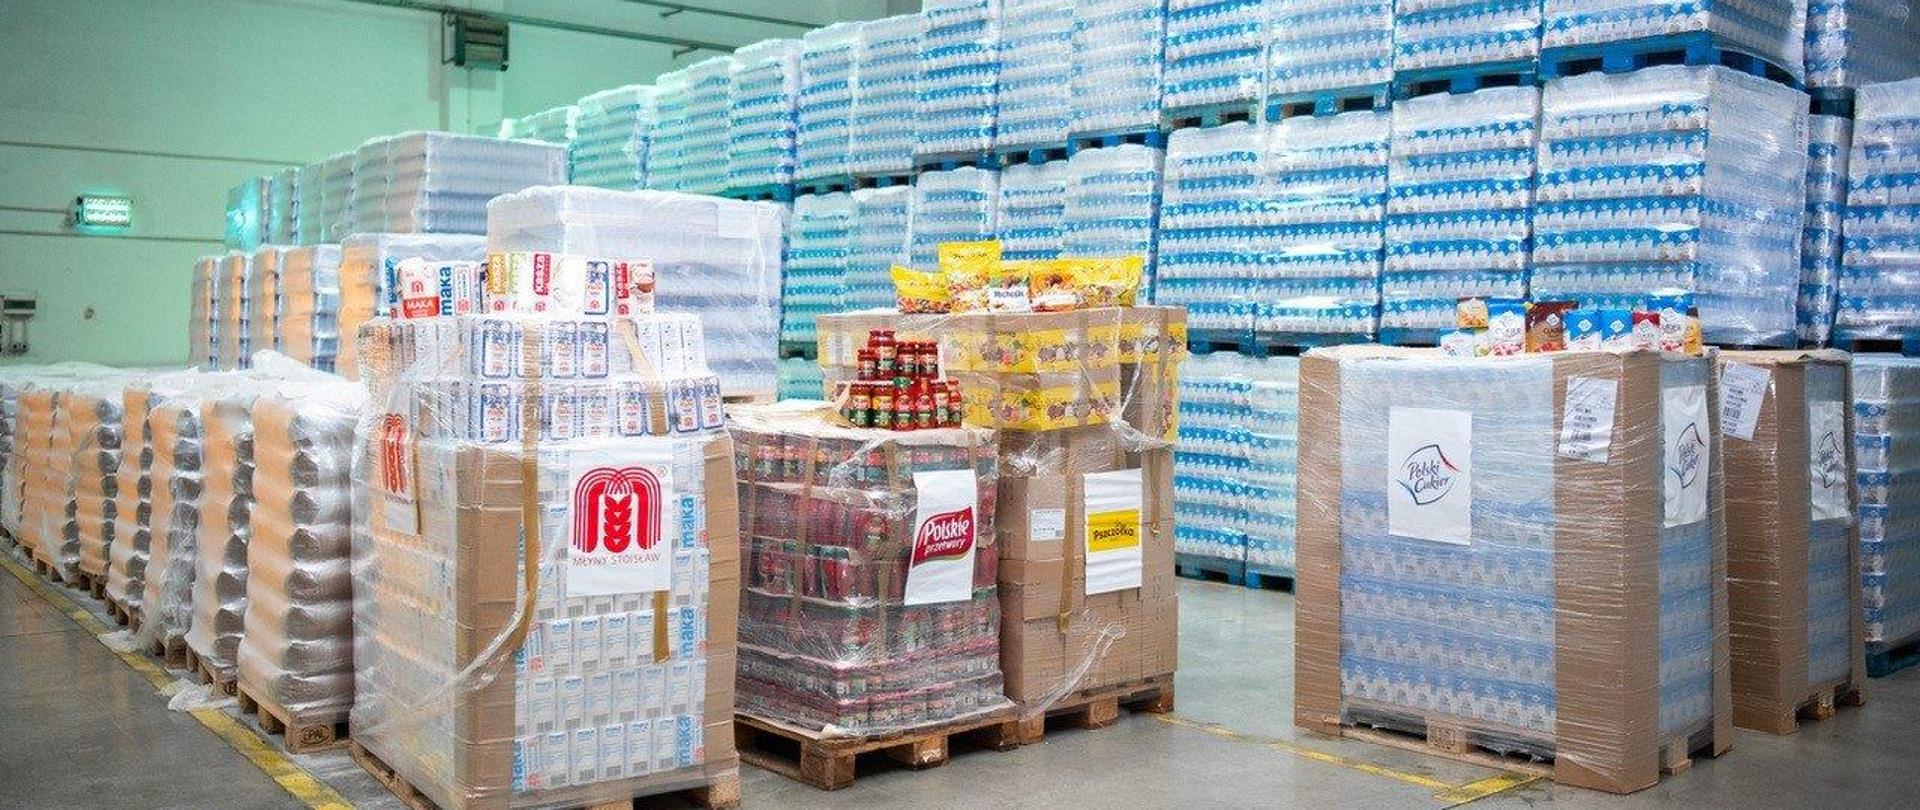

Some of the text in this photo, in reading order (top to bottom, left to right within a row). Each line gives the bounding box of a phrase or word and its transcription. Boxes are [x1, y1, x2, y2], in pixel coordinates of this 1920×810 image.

[1408, 460, 1440, 480] Polski
[1415, 475, 1450, 493] Cukier
[922, 515, 970, 546] Polskie
[924, 538, 967, 557] przetwory
